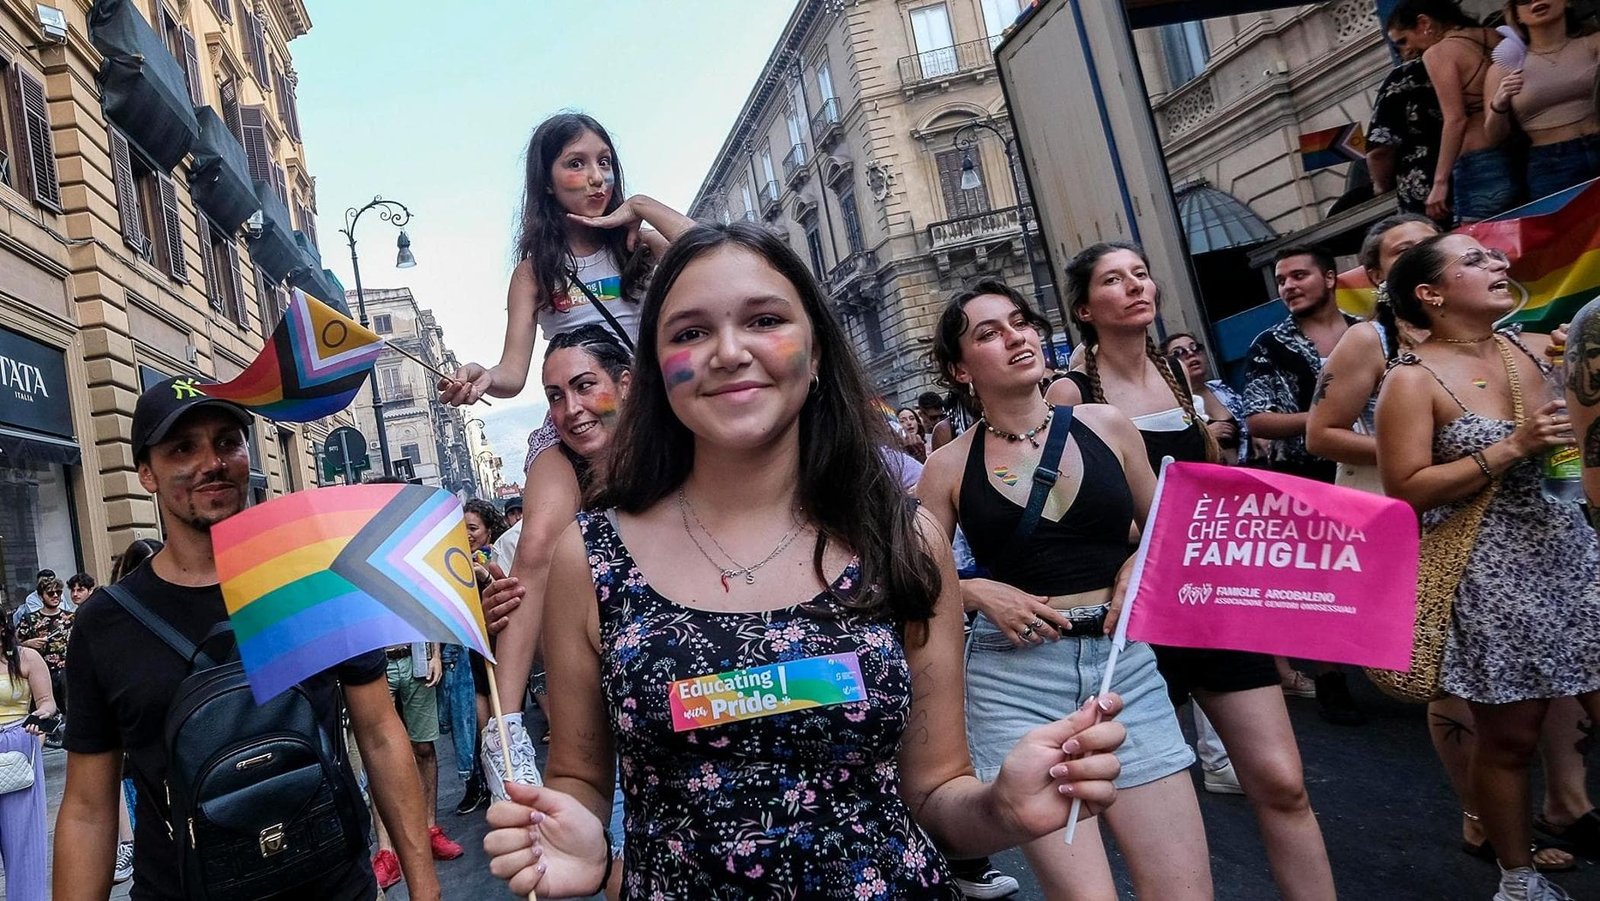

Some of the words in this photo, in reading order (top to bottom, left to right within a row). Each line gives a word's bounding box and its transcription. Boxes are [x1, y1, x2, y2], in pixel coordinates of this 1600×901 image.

[14, 391, 34, 403] ITALIA
[1192, 493, 1213, 520] È
[1187, 520, 1230, 541] CHE
[1235, 519, 1299, 541] CREA
[1306, 520, 1367, 543] UNA
[1182, 541, 1362, 572] FAMIGLIA
[1216, 586, 1261, 599] FAMIGLIE
[1265, 588, 1336, 603] ARCOBALENO
[678, 669, 774, 700] Educating
[683, 705, 709, 719] with
